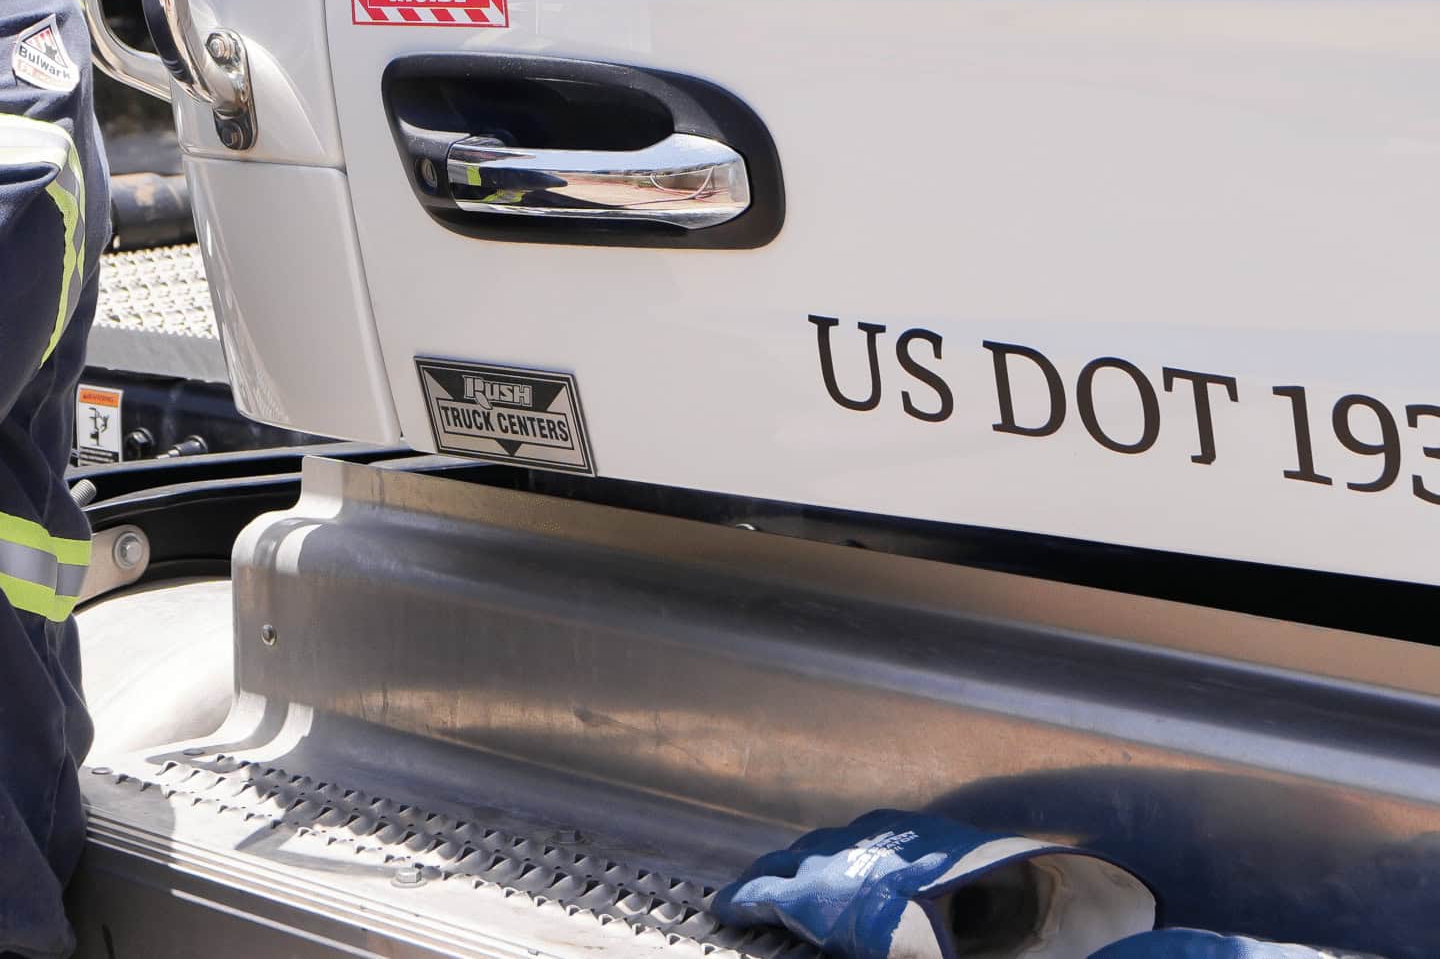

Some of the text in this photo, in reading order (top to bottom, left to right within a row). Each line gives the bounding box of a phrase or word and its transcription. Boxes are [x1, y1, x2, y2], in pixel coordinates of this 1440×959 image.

[18, 44, 71, 80] Bulwark
[462, 374, 533, 411] RUSH
[807, 314, 954, 423] US
[982, 339, 1240, 466] DOT
[441, 405, 569, 443] TRUCK CENTERS
